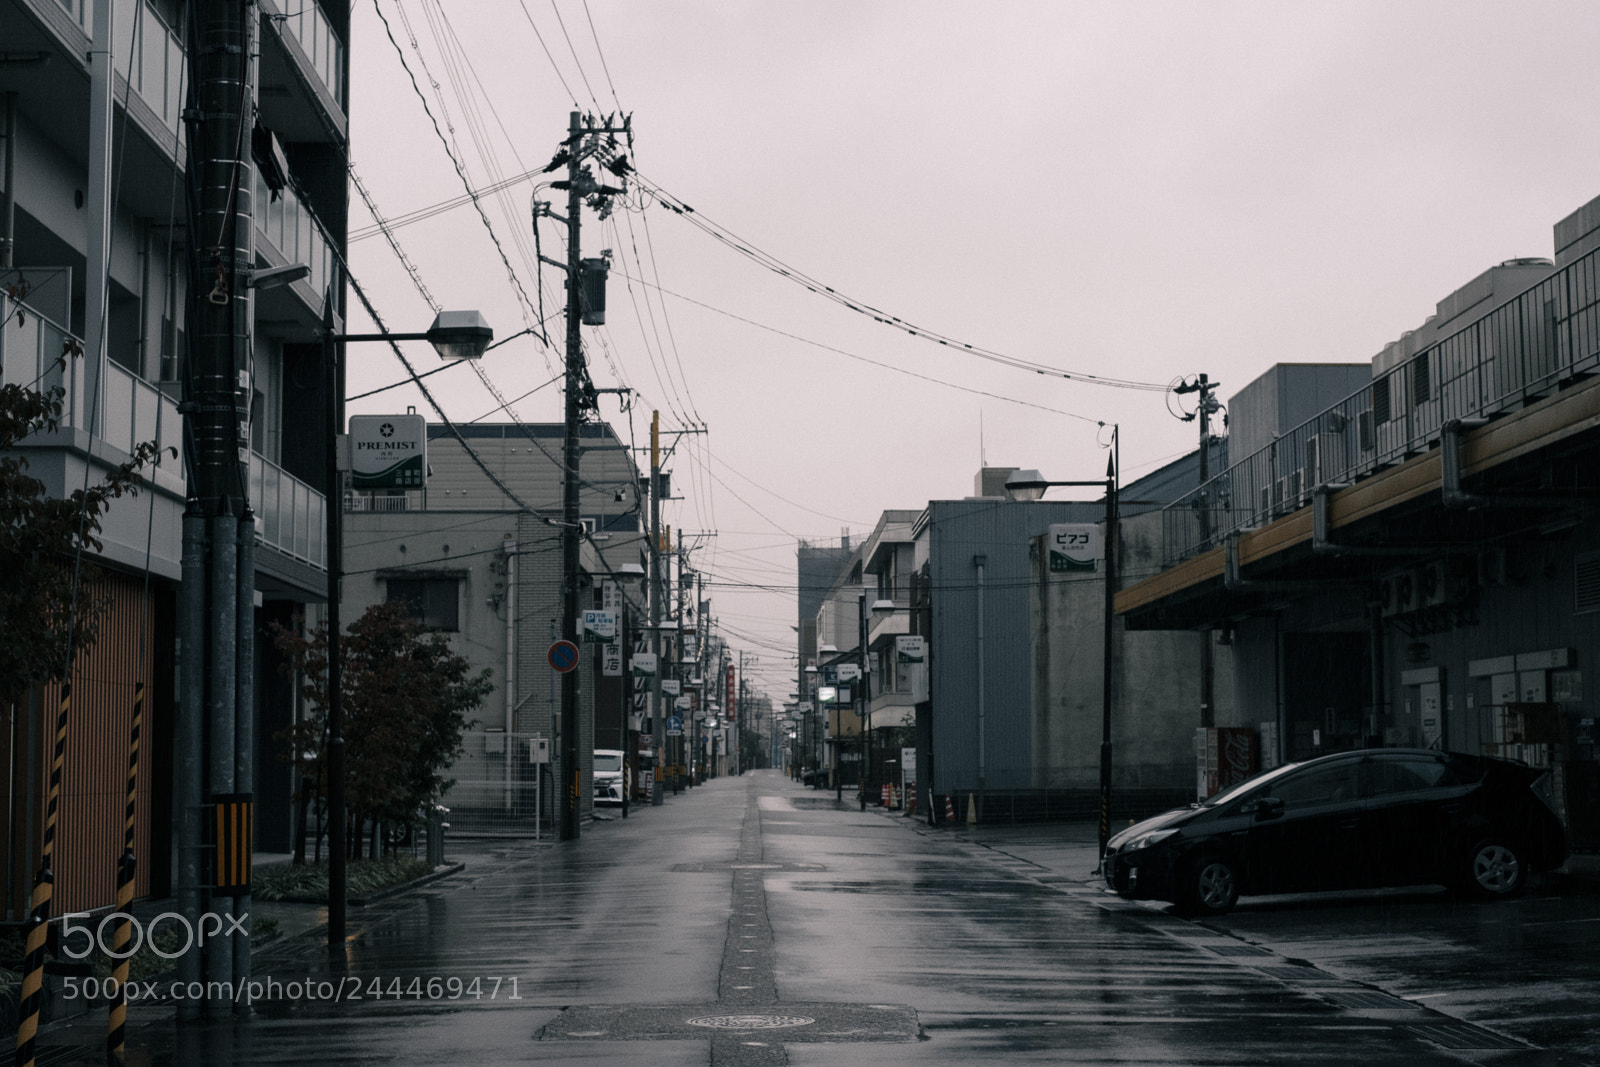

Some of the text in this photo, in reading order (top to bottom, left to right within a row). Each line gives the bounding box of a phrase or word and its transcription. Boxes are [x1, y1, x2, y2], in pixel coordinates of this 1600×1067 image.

[357, 441, 417, 450] PREMIST
[587, 613, 595, 622] P
[1224, 729, 1250, 785] ca-Cola
